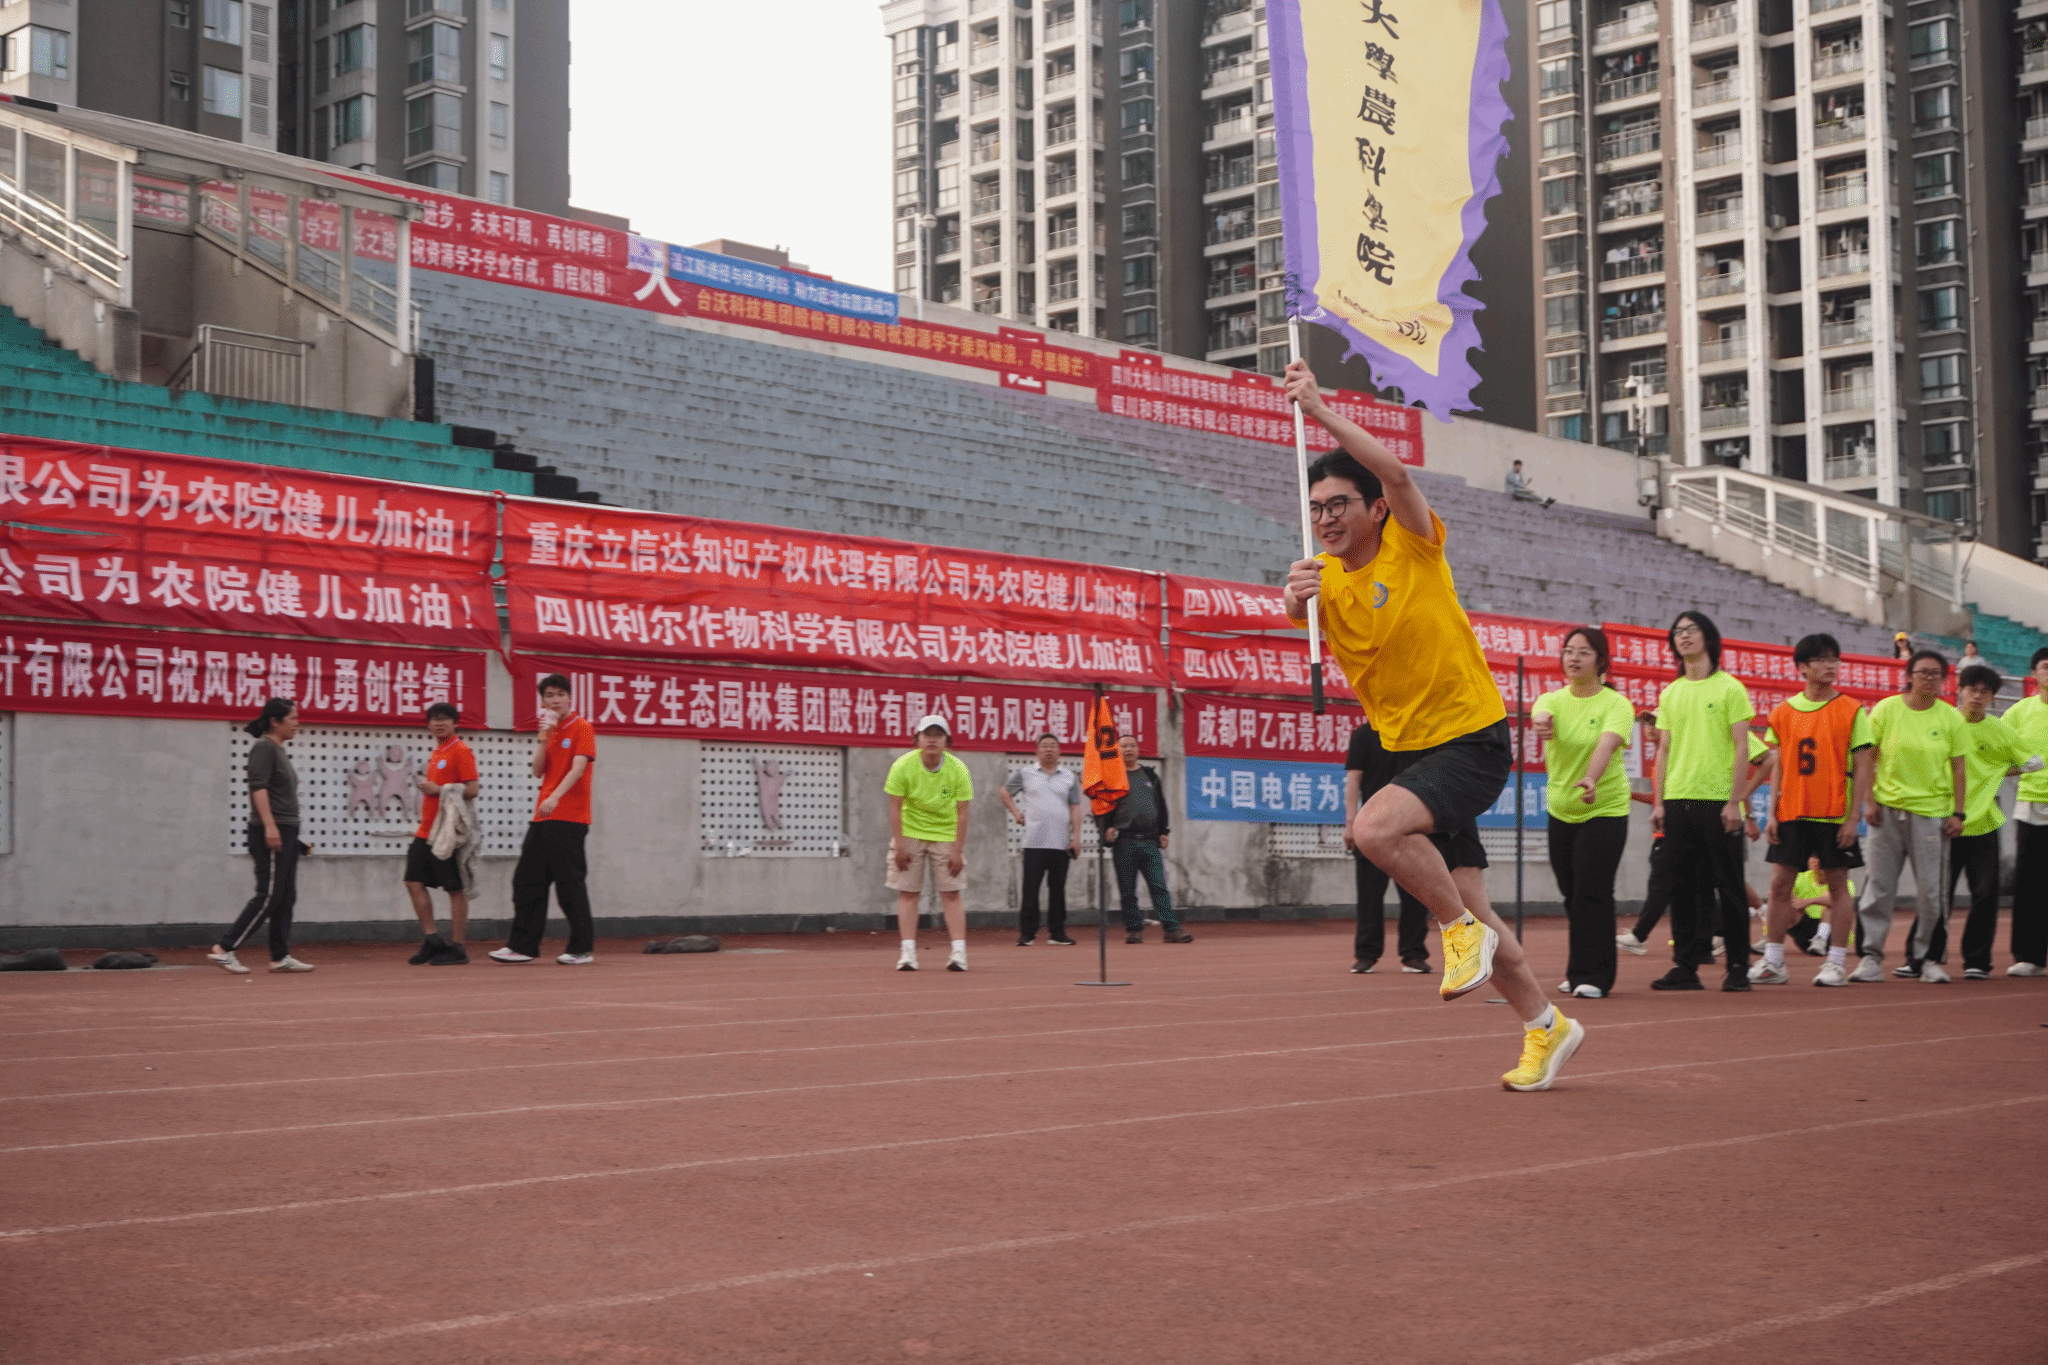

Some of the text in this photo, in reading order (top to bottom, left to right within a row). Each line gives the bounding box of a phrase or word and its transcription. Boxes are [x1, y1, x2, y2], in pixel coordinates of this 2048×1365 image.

[1474, 622, 1565, 658] 农院健儿加
[535, 671, 1144, 745] 川天艺生态园林集团股份有限公司为风院健儿油！
[1198, 704, 1369, 753] 成都甲乙丙景观设
[1798, 737, 1816, 776] 6
[1201, 768, 1346, 812] 中国电信为
